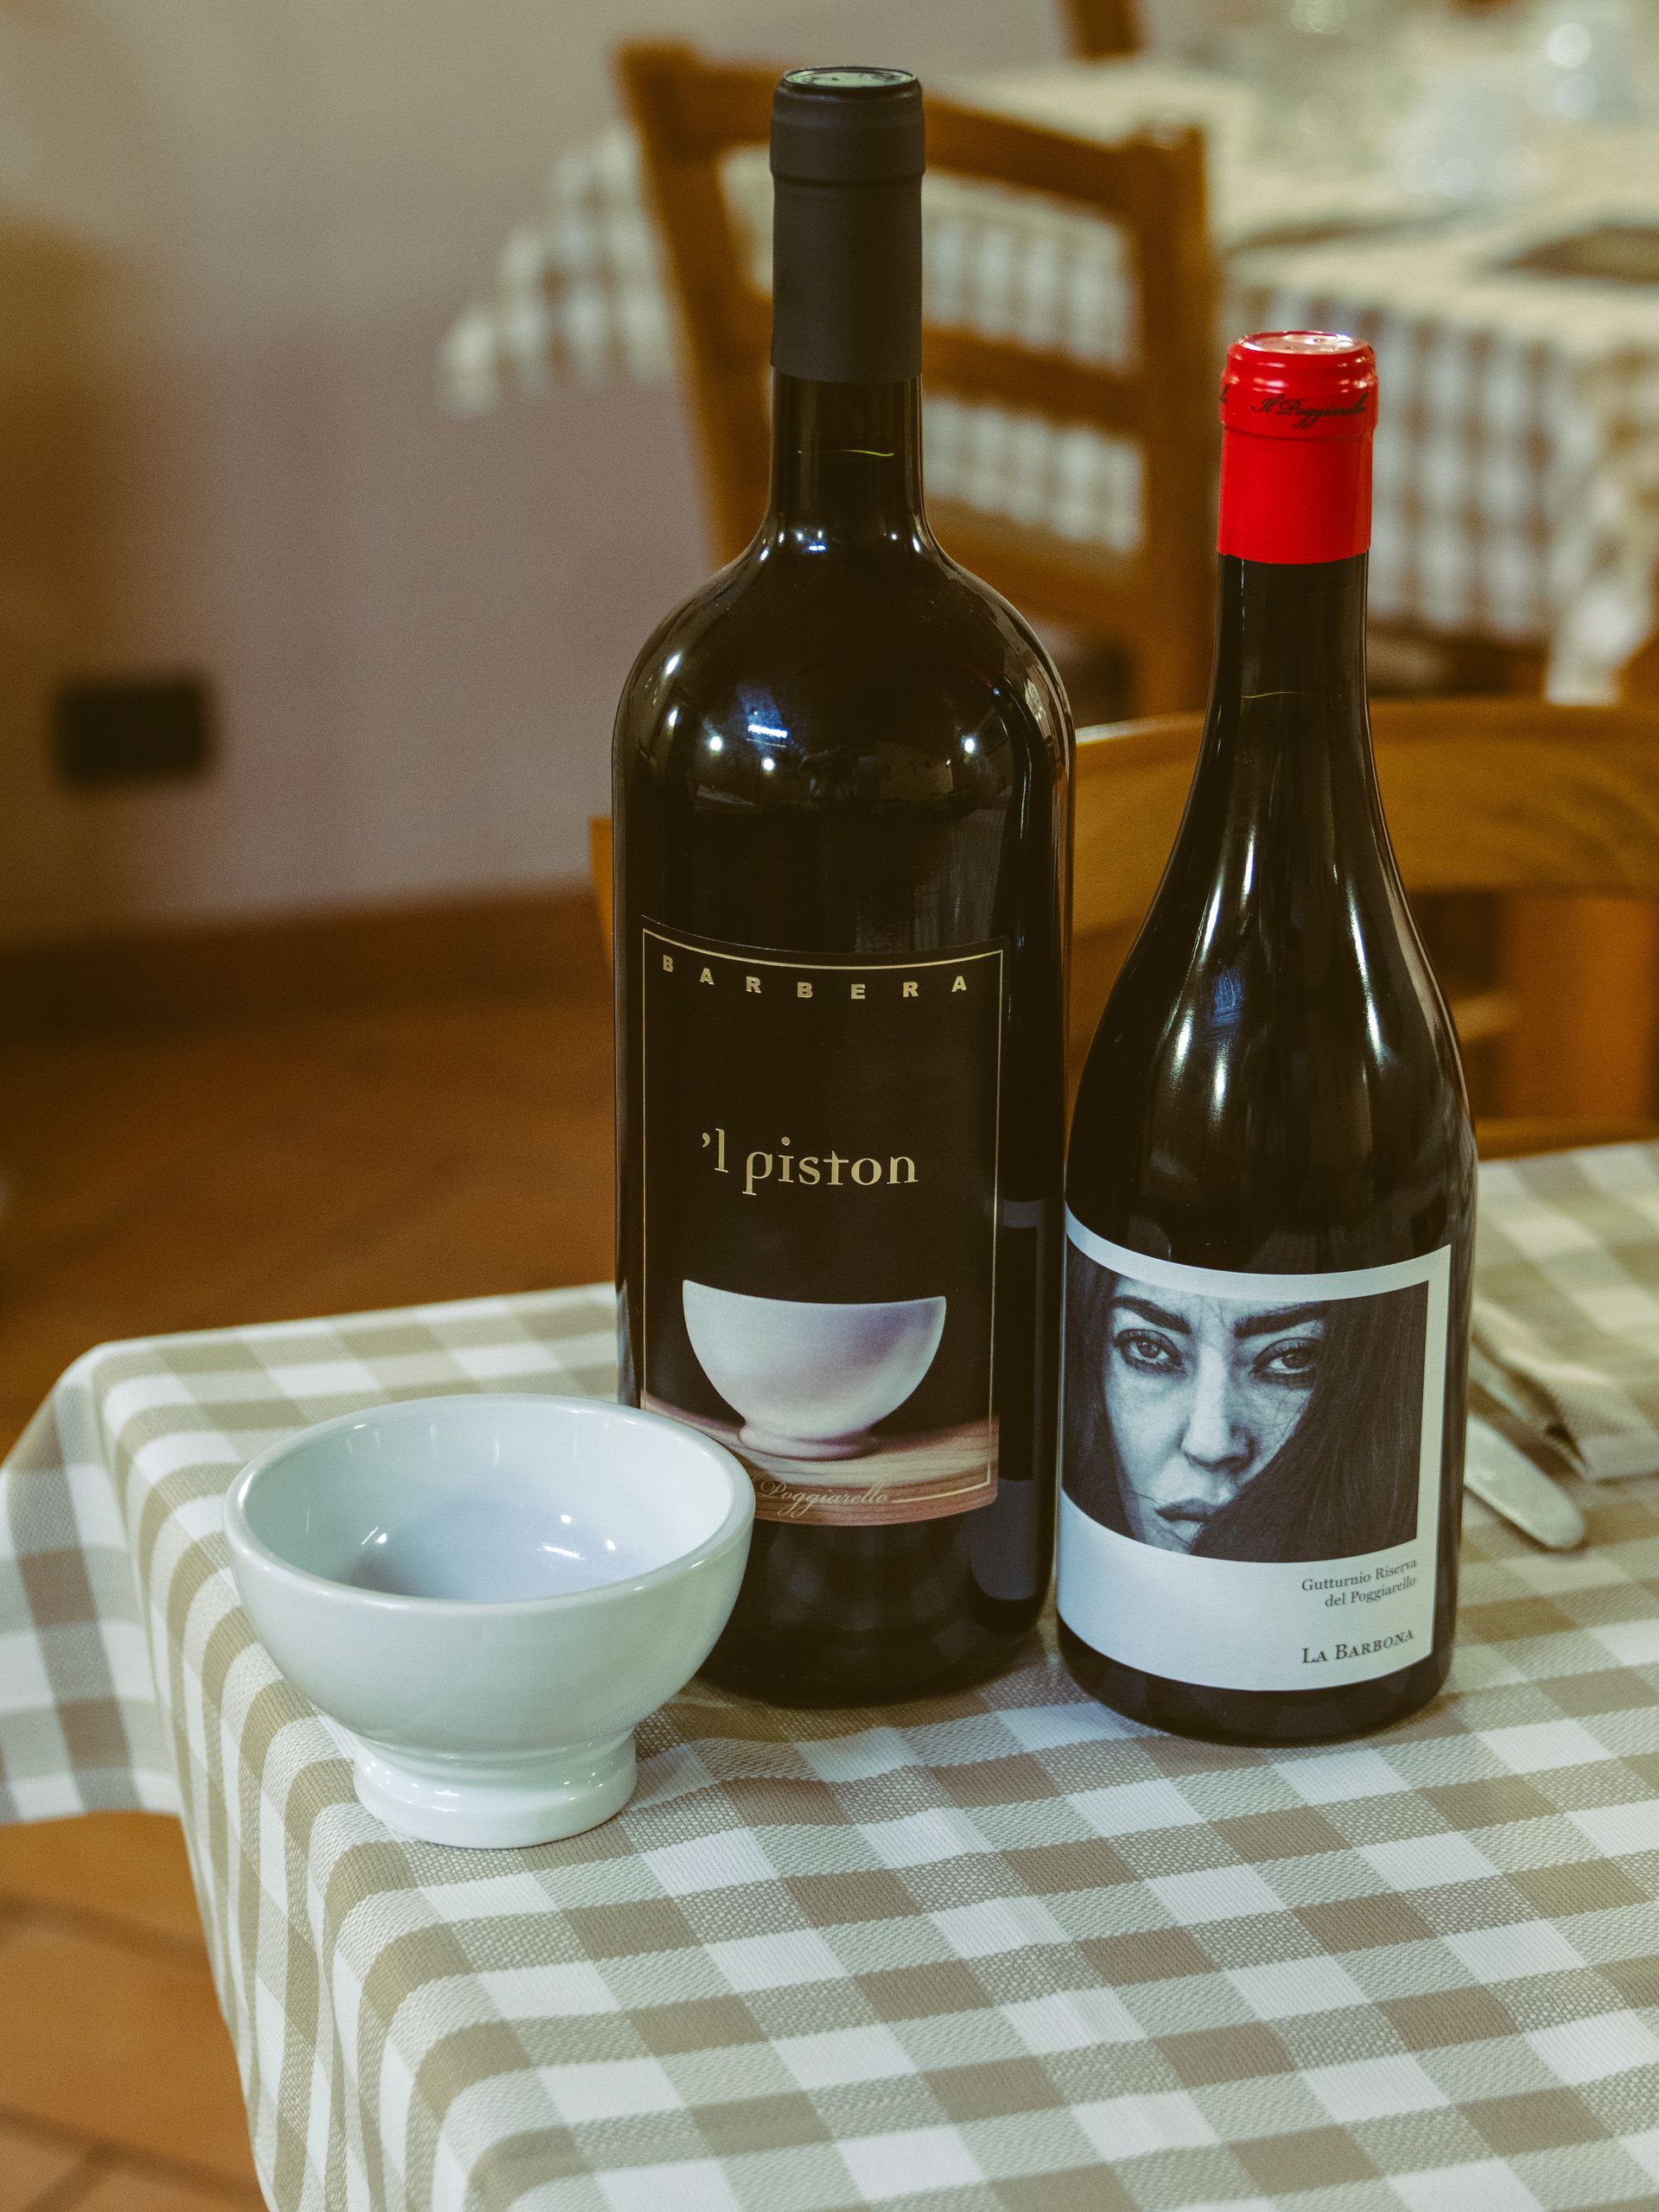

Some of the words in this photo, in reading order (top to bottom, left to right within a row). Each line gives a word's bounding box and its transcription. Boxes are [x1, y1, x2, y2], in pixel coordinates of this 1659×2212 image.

[662, 954, 967, 1000] BARBERA
[741, 1136, 918, 1196] piston
[756, 1478, 889, 1519] Poggiarello
[1301, 1571, 1371, 1592] Gutturnio
[1375, 1559, 1417, 1580] Riserva
[1325, 1594, 1346, 1607] del
[1351, 1575, 1416, 1604] Poggiarello
